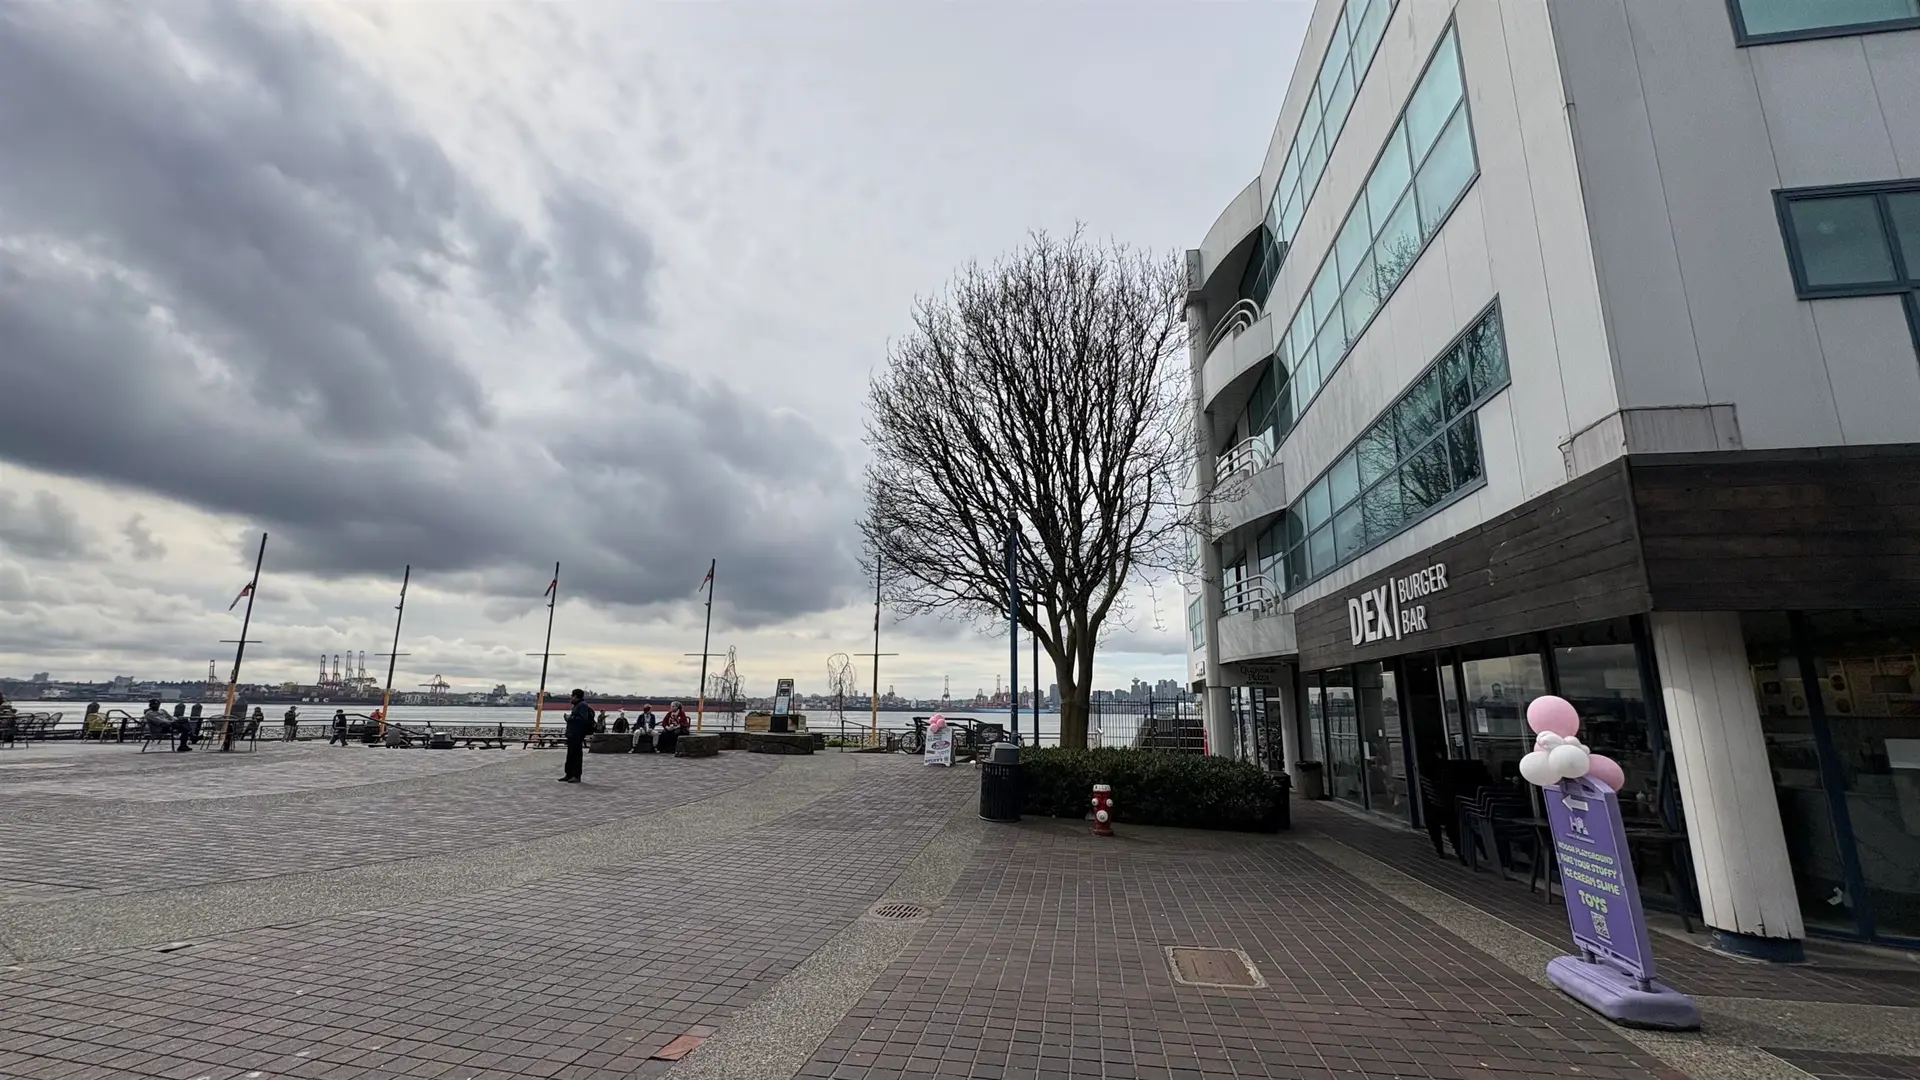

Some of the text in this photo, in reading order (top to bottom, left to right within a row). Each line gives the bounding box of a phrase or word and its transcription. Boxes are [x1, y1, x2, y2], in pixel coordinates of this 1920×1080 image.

[1398, 563, 1448, 603] BURGER
[1348, 585, 1393, 646] DEX
[1401, 605, 1428, 634] BAR
[1574, 858, 1591, 871] YOUR
[1591, 863, 1617, 879] STUFFY
[1575, 847, 1614, 865] PLAYGROUND
[1563, 866, 1621, 896] ICE CREAM SLIME
[1578, 889, 1608, 914] TOYS
